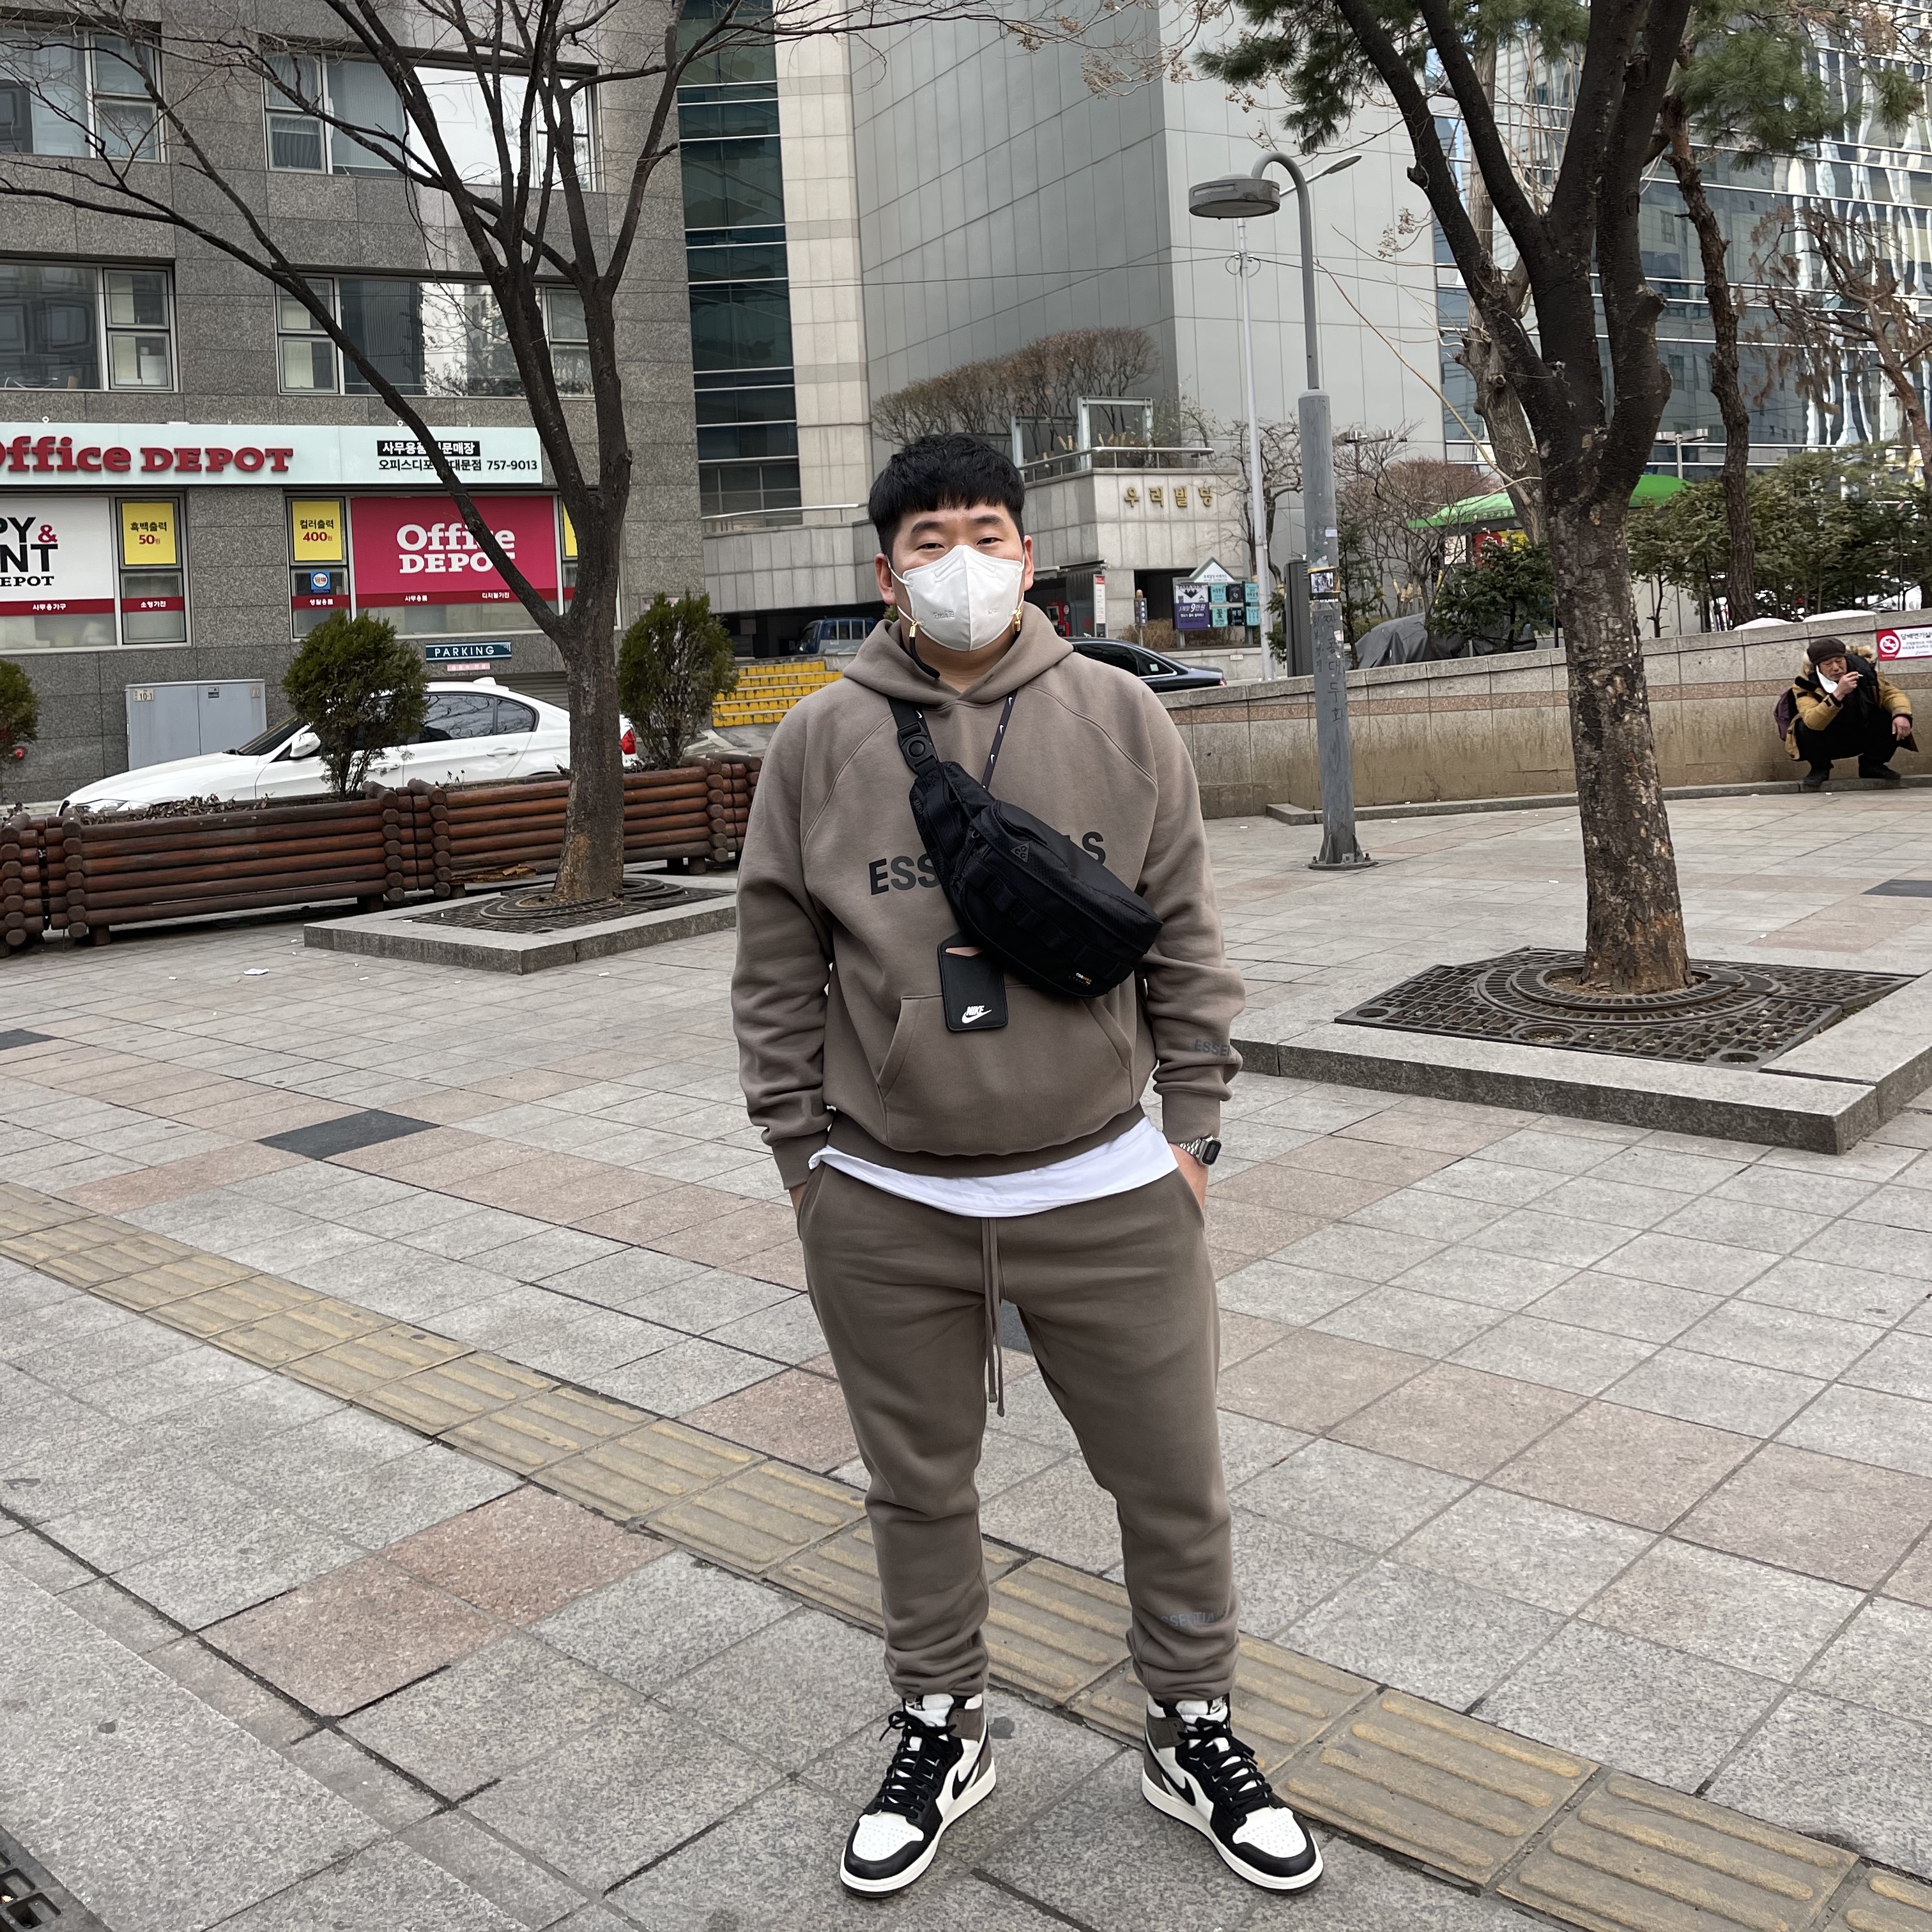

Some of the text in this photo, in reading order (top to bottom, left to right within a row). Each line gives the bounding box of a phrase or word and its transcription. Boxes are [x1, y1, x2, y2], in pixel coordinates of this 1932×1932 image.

[0, 436, 293, 471] ffice DEPOT
[438, 441, 475, 454] 문매장
[447, 459, 482, 471] 대문점
[487, 460, 537, 470] 757-9013
[1124, 487, 1212, 507] 우리빌딩
[130, 521, 167, 532] 흑백출력
[300, 519, 334, 529] 컬러출력
[303, 532, 333, 541] 400원
[397, 523, 515, 551] Offie
[0, 576, 54, 586] EPOT
[434, 645, 494, 657] PARKING
[965, 1005, 985, 1016] NIKE
